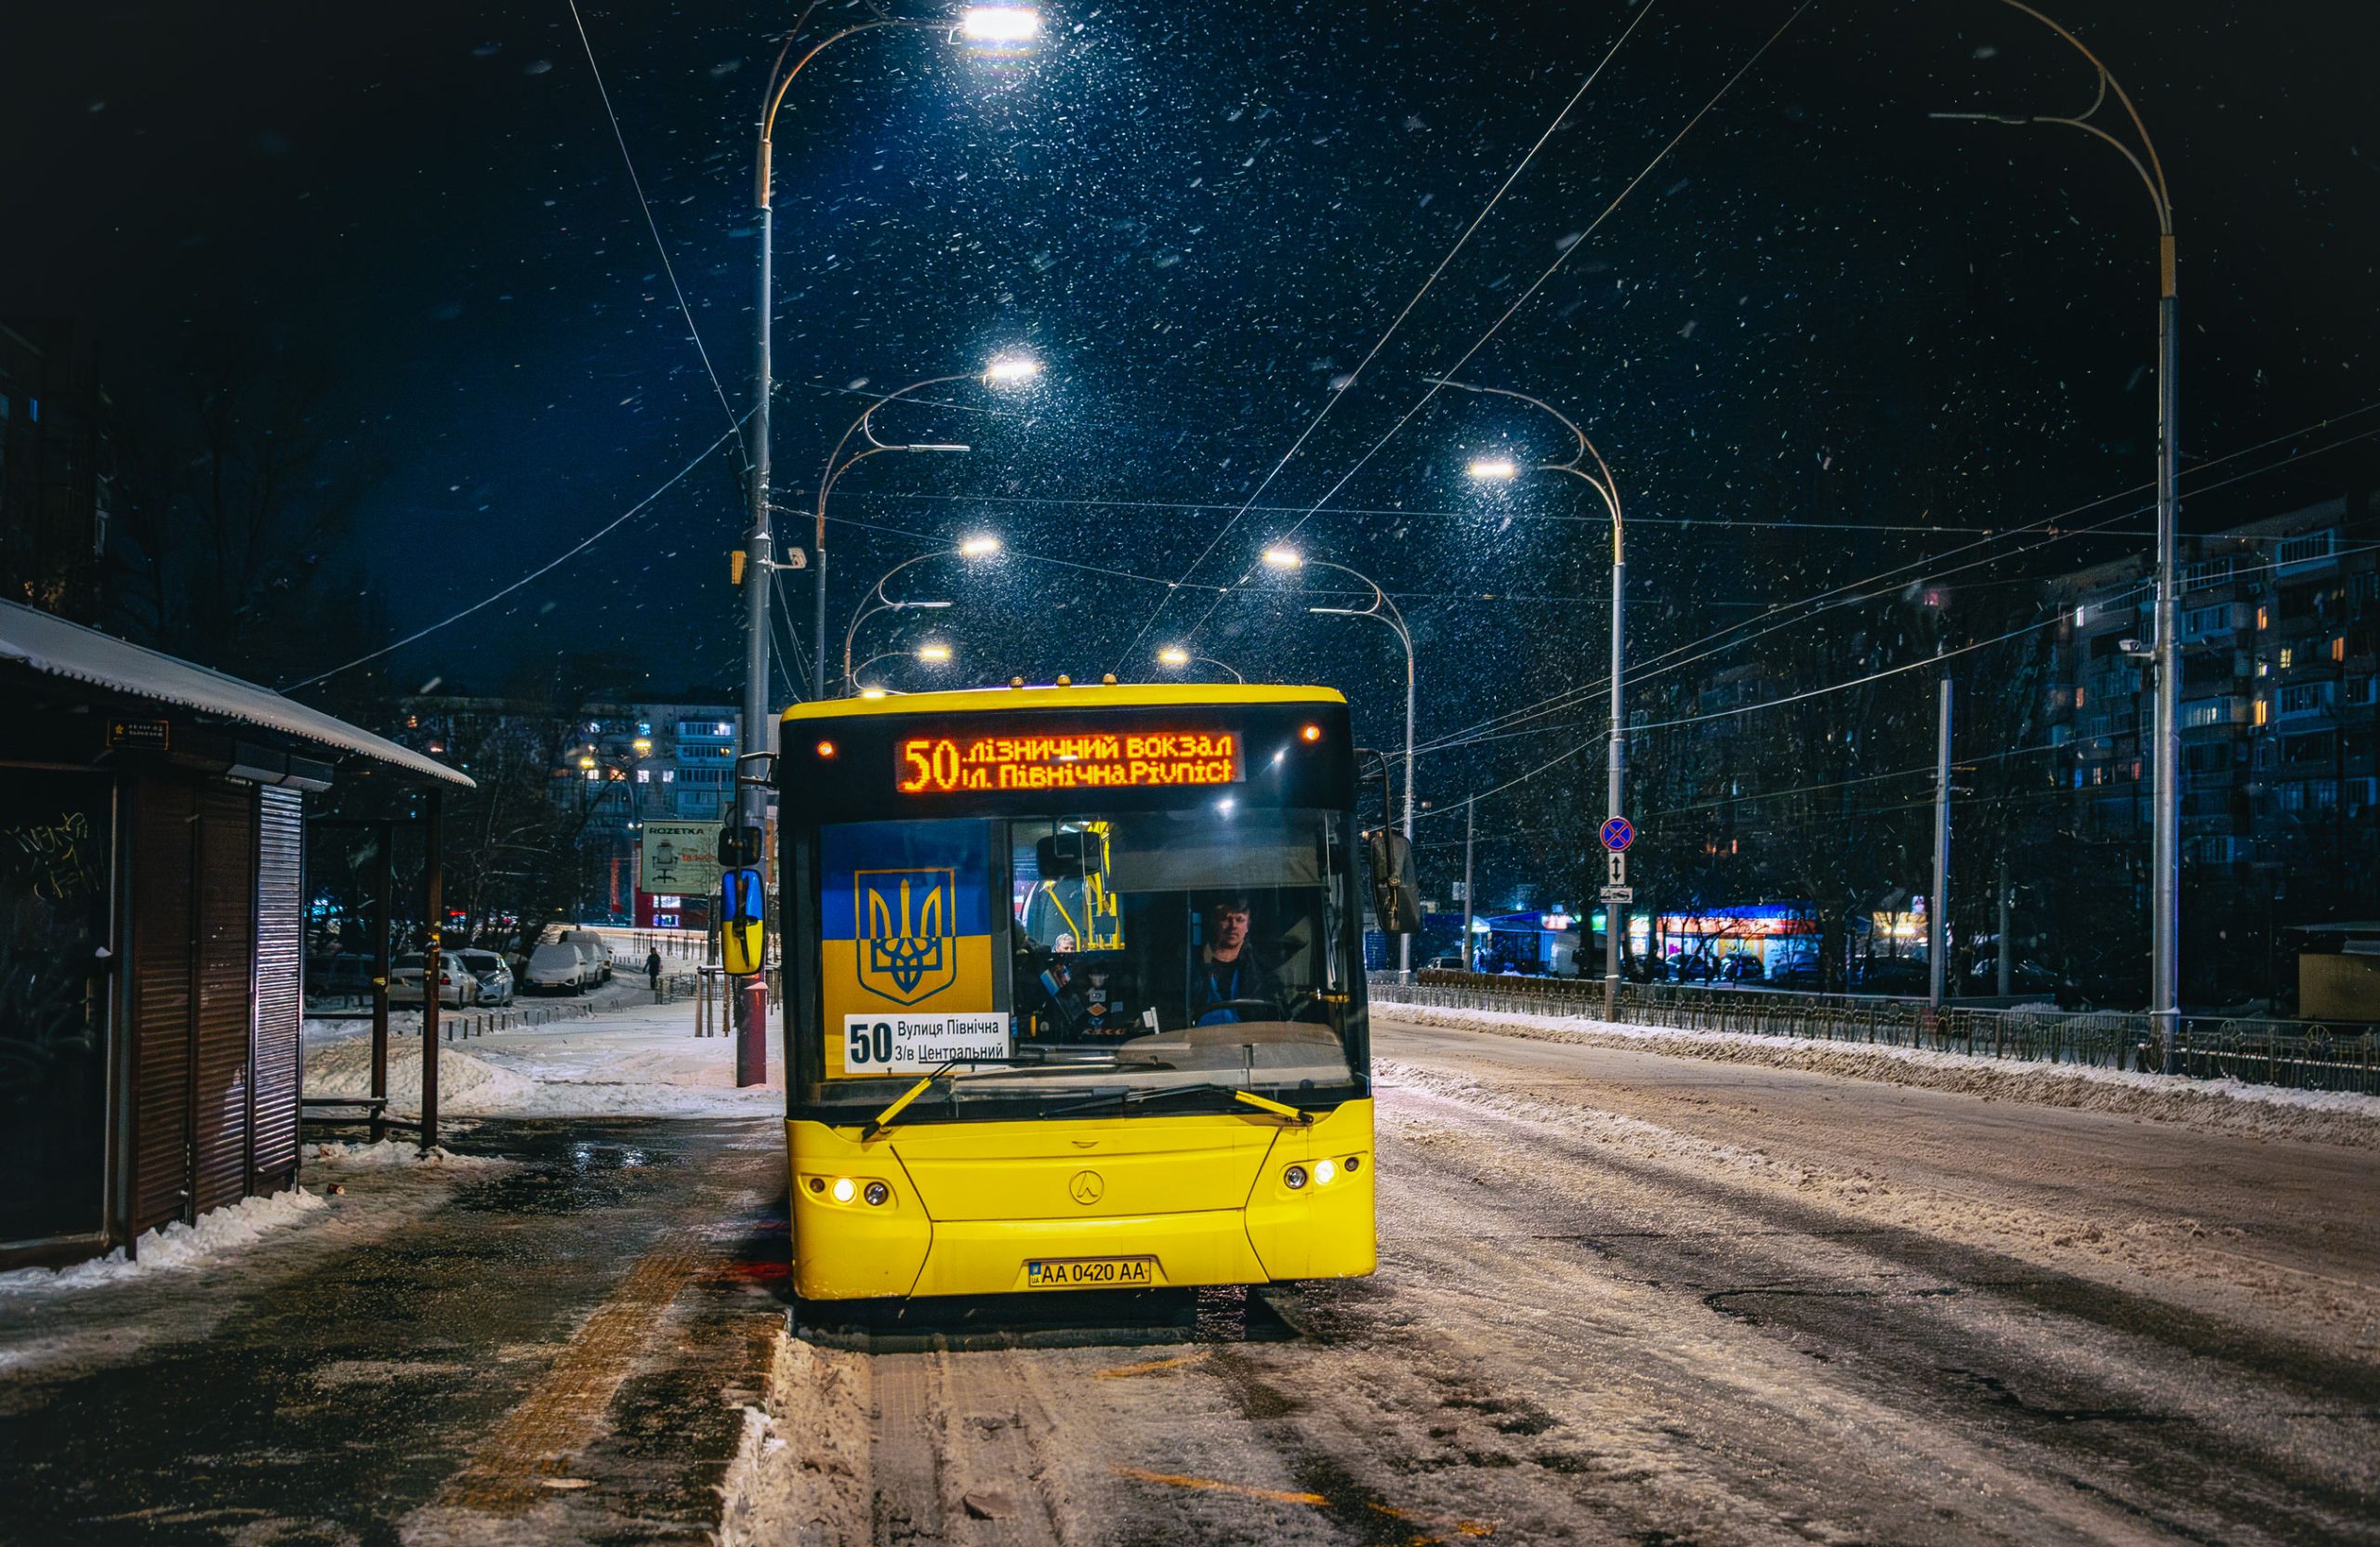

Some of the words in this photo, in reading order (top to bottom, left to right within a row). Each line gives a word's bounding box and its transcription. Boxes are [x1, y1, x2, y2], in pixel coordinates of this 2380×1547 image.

[961, 736, 1119, 762] лізничний
[1127, 735, 1232, 759] вокзал
[904, 740, 959, 790] 50
[999, 762, 1129, 788] Північна
[897, 1021, 944, 1039] Вулиця
[947, 1019, 999, 1036] Північна
[850, 1023, 892, 1064] 50
[919, 1041, 1004, 1063] Центральний
[1041, 1264, 1068, 1283] AA
[1073, 1263, 1115, 1282] 0420
[1119, 1263, 1145, 1281] AA
